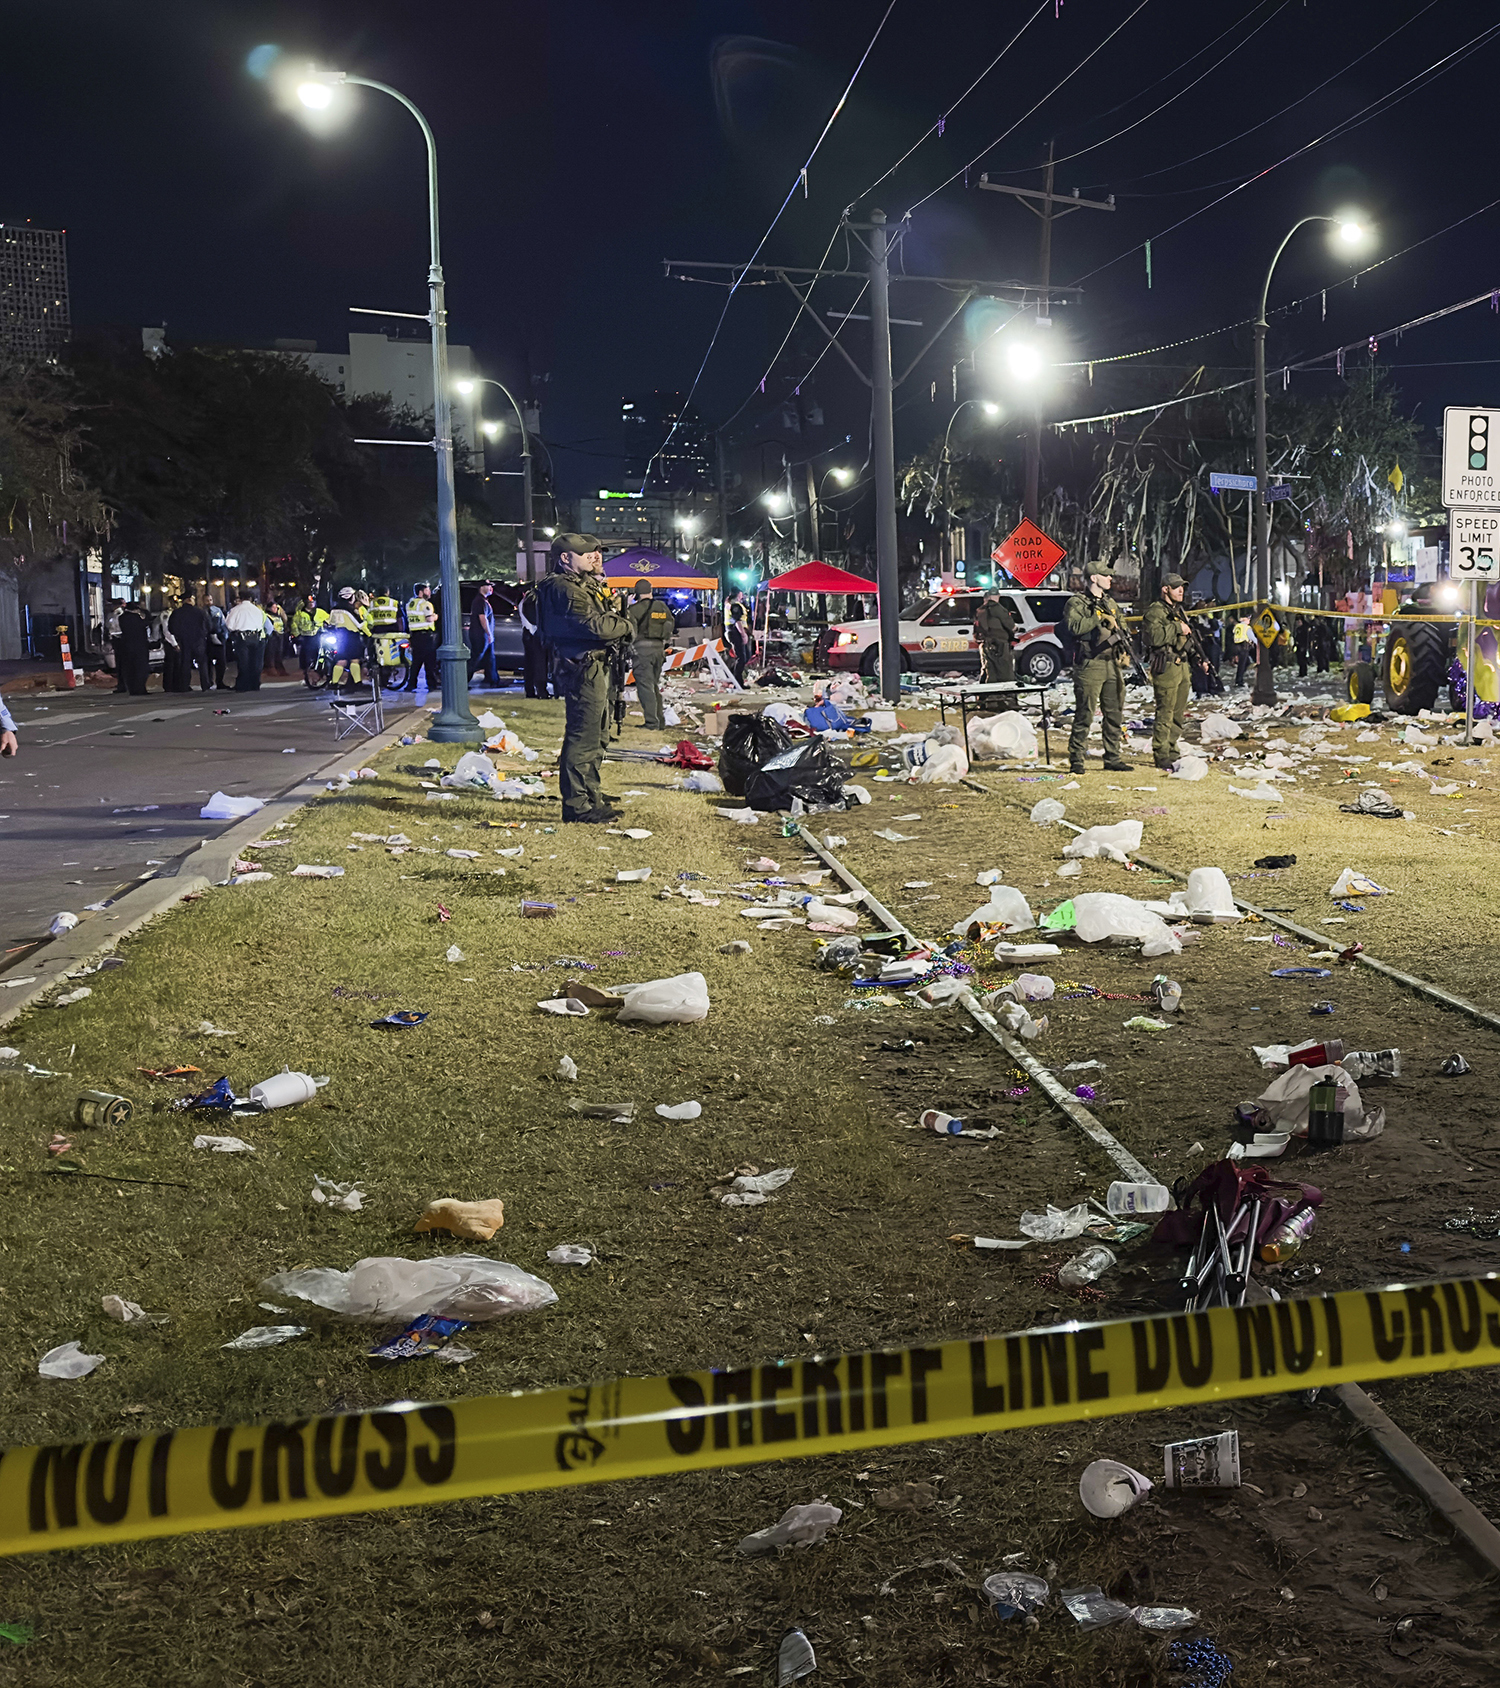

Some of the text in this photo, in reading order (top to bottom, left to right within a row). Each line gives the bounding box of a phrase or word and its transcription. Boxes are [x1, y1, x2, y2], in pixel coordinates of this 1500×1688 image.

[1214, 476, 1254, 488] Terpsichore
[1461, 475, 1494, 487] PHOTO
[1456, 518, 1498, 530] SPEED
[1013, 537, 1042, 547] ROAD
[1460, 533, 1493, 544] LIMIT
[1015, 550, 1044, 560] WORK
[1458, 546, 1494, 572] 35
[1013, 562, 1048, 573] AHEAD
[940, 640, 969, 652] FIRE
[666, 1347, 942, 1456] SHERIFF
[969, 1329, 1109, 1416] LINE
[1131, 1310, 1213, 1395] DO
[1234, 1295, 1343, 1380] NOT
[29, 1406, 456, 1533] NOT CROSS
